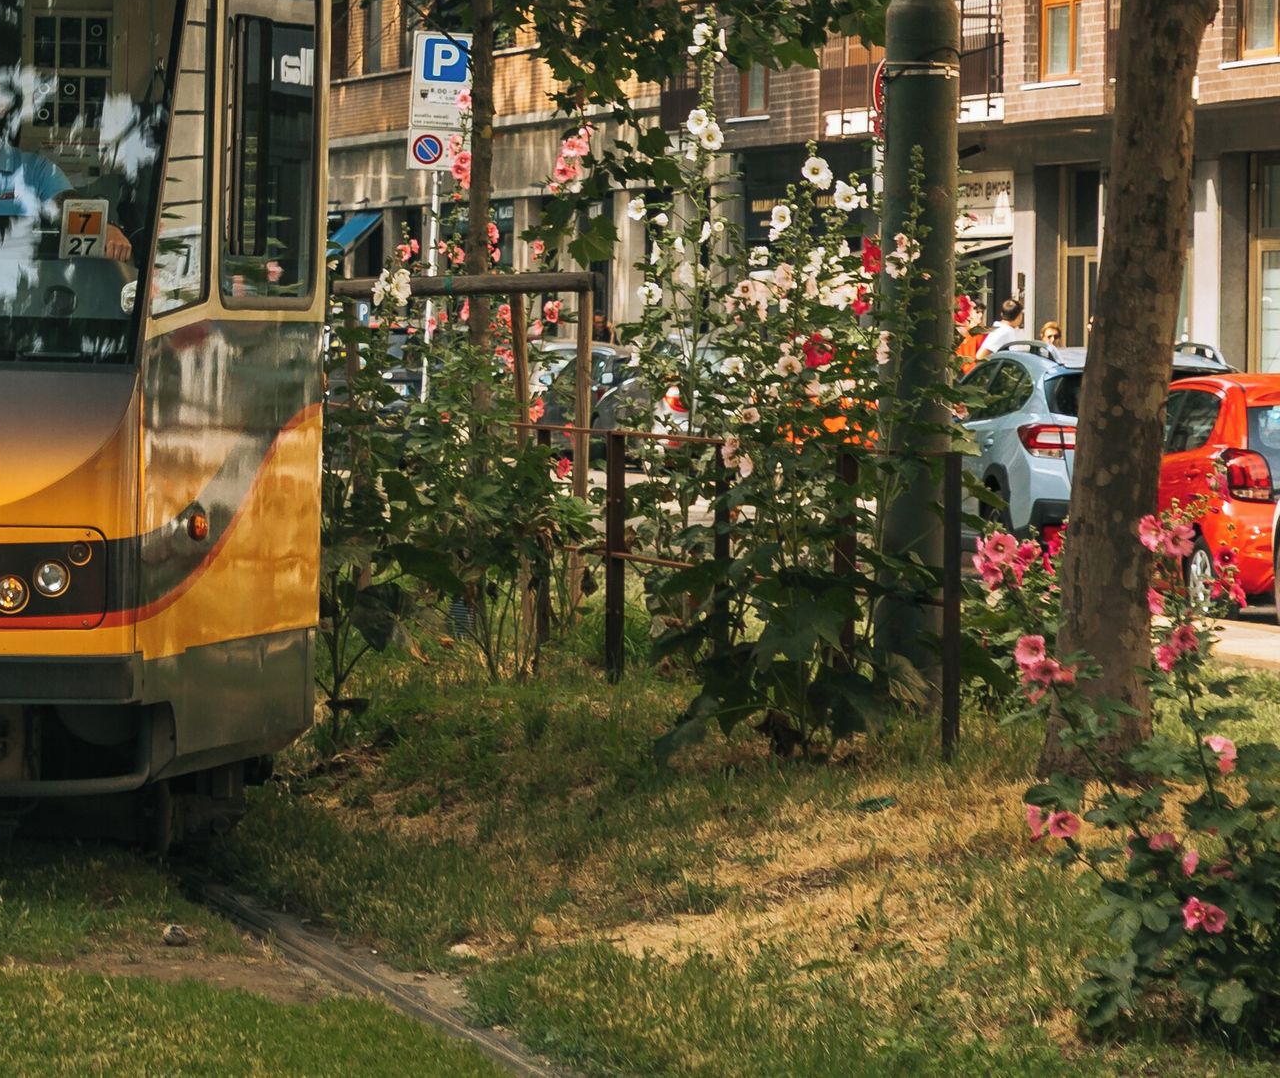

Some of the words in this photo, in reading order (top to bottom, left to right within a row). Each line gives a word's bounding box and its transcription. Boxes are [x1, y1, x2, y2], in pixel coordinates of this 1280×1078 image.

[432, 43, 460, 77] P
[79, 213, 92, 235] 7
[68, 237, 97, 256] 27
